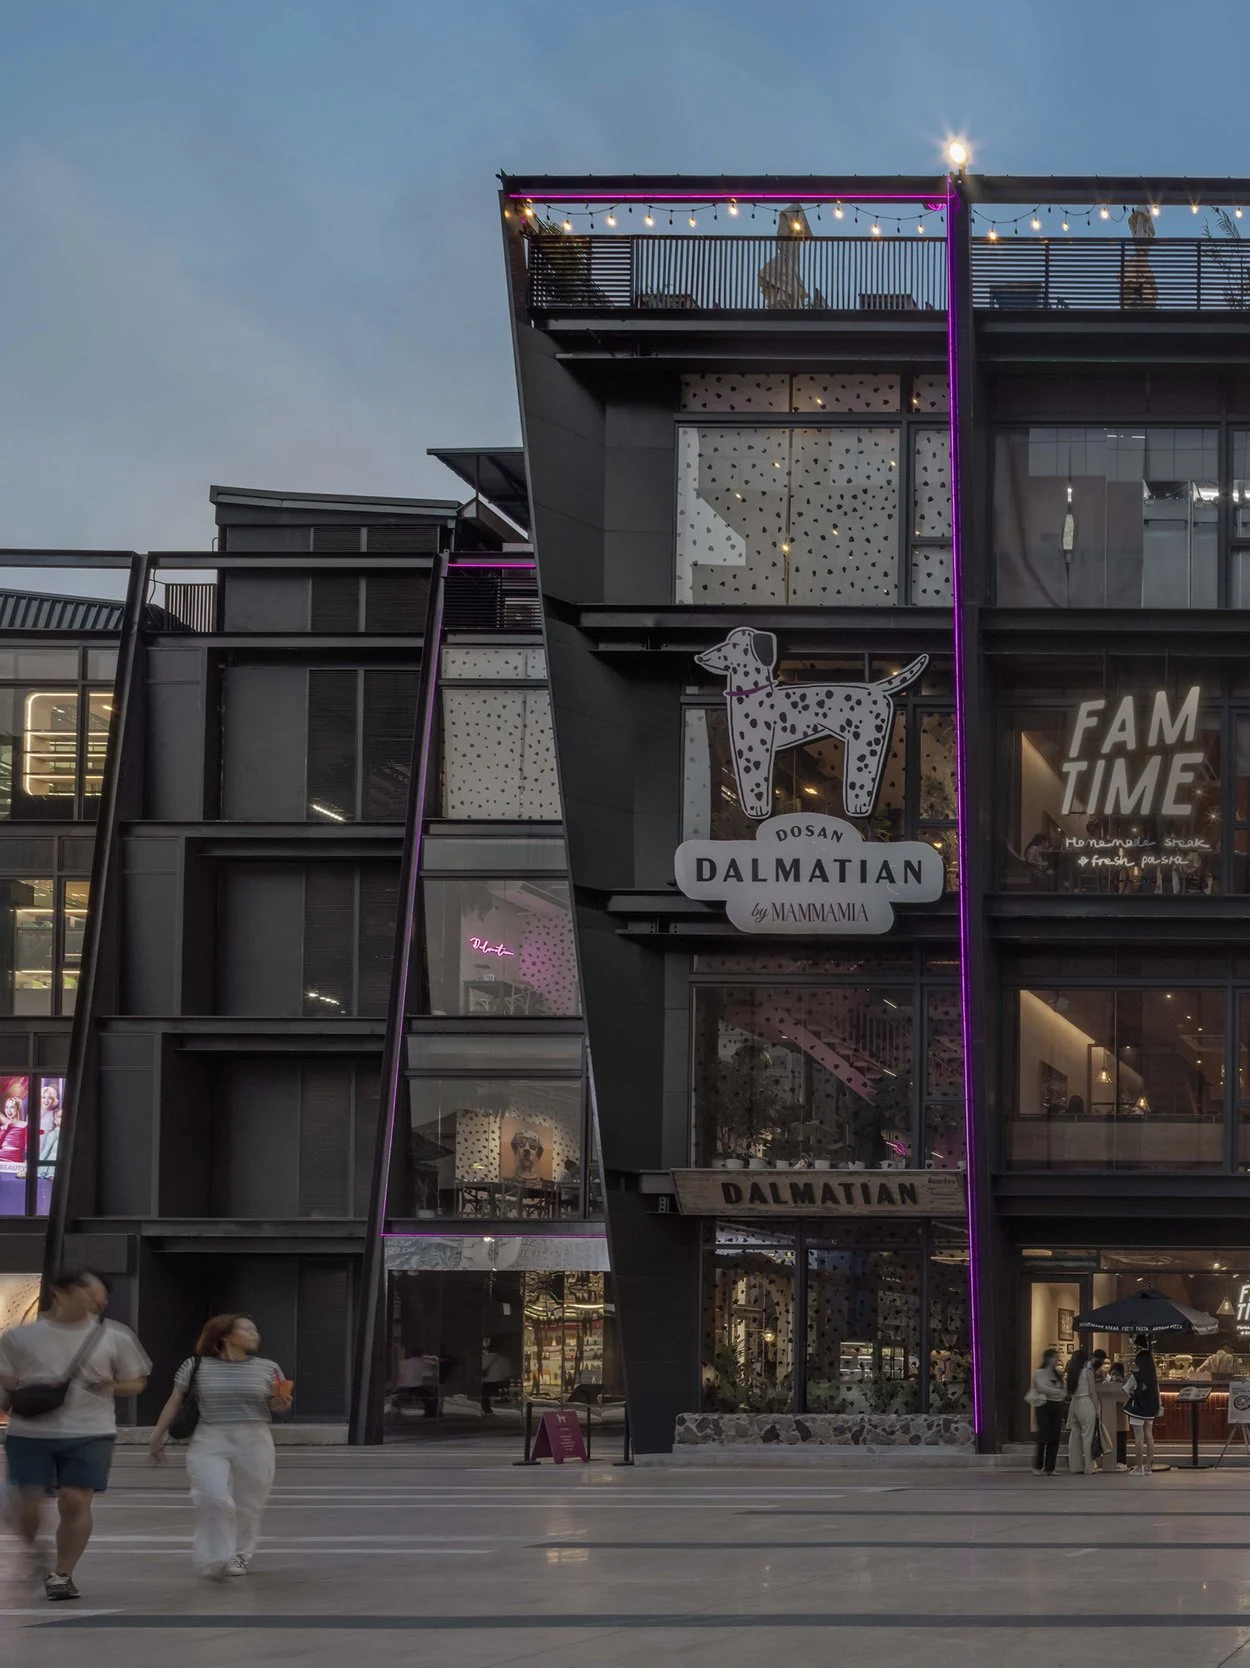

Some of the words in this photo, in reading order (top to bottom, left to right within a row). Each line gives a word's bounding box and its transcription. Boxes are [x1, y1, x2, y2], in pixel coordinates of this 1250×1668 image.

[1069, 686, 1200, 758] FAM
[1061, 752, 1204, 815] TIME
[775, 824, 843, 843] DOSAN
[1163, 837, 1210, 848] steak
[695, 857, 923, 885] DALMATIAN
[1141, 855, 1189, 868] pasta
[751, 903, 770, 924] by
[771, 902, 869, 922] MAMMAMIA
[720, 1181, 919, 1206] DALMATIAN
